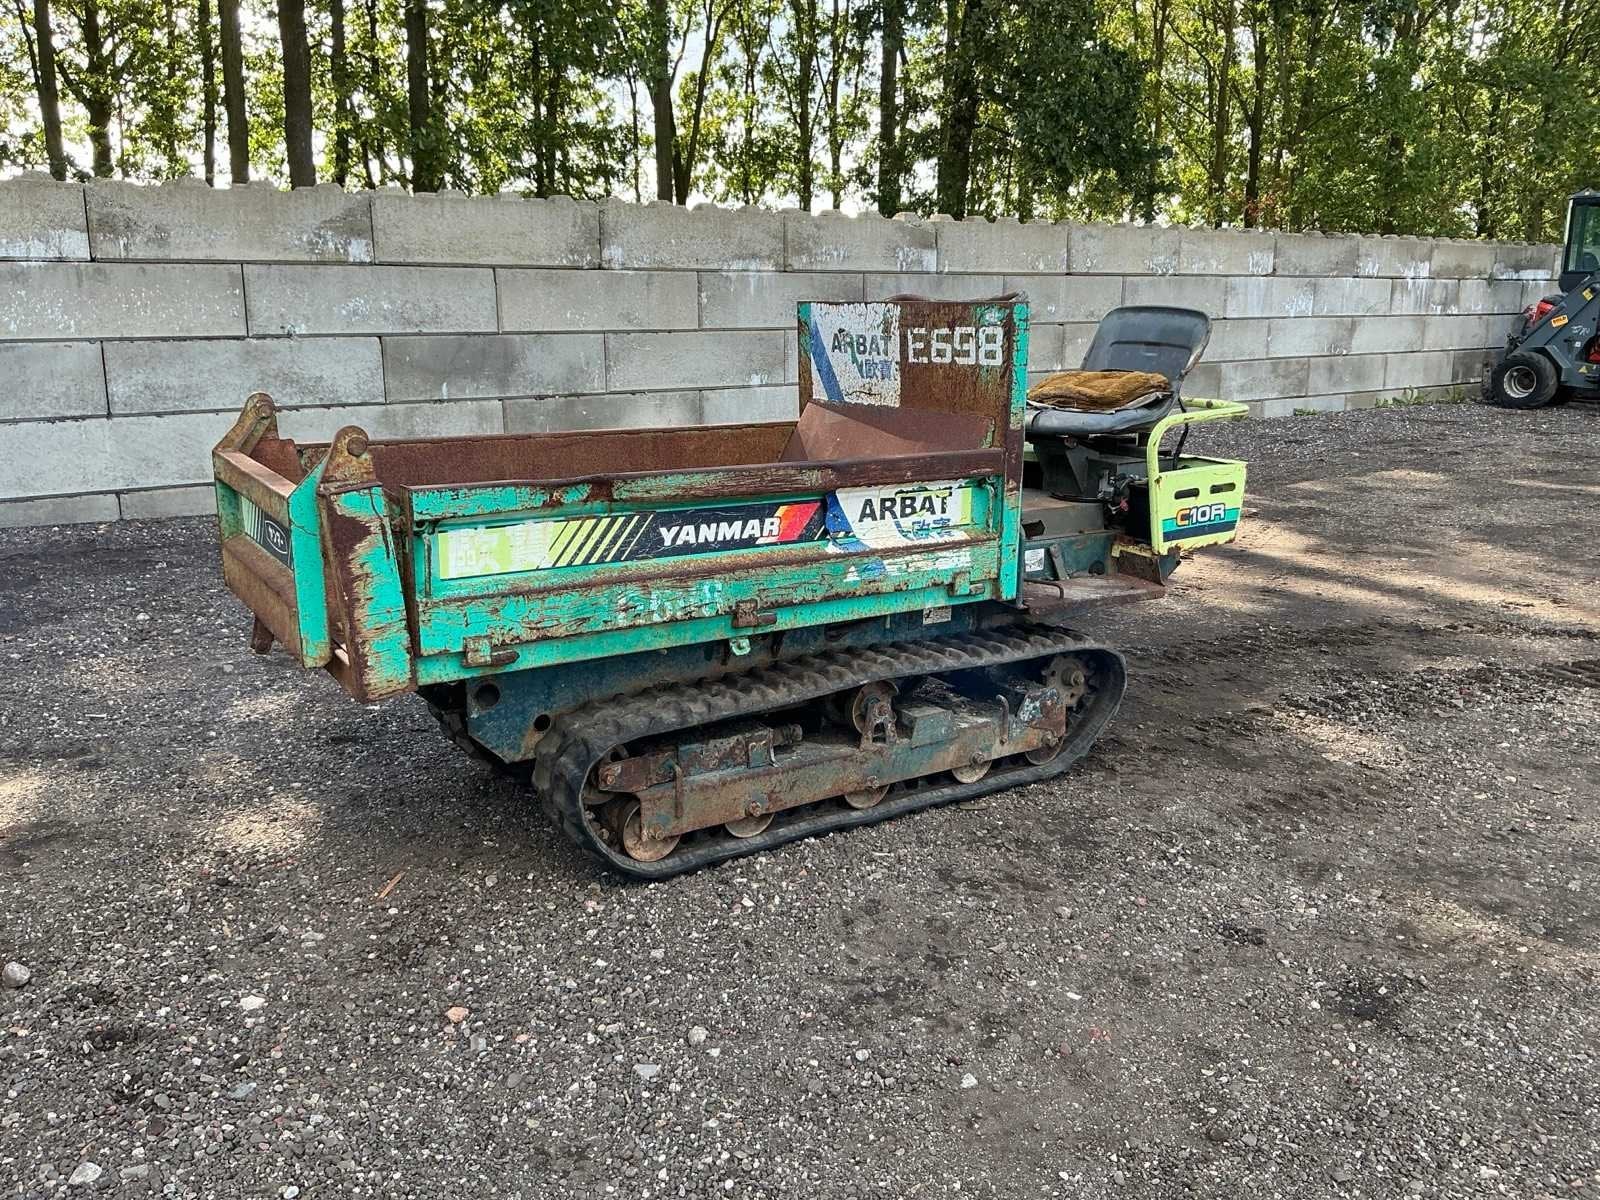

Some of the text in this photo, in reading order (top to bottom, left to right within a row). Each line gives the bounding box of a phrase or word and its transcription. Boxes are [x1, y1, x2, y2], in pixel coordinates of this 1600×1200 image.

[831, 332, 893, 357] ARBAT
[908, 326, 1004, 366] E698
[858, 491, 953, 523] ARBAT
[1175, 503, 1226, 528] C10R
[659, 516, 782, 547] YANMAR
